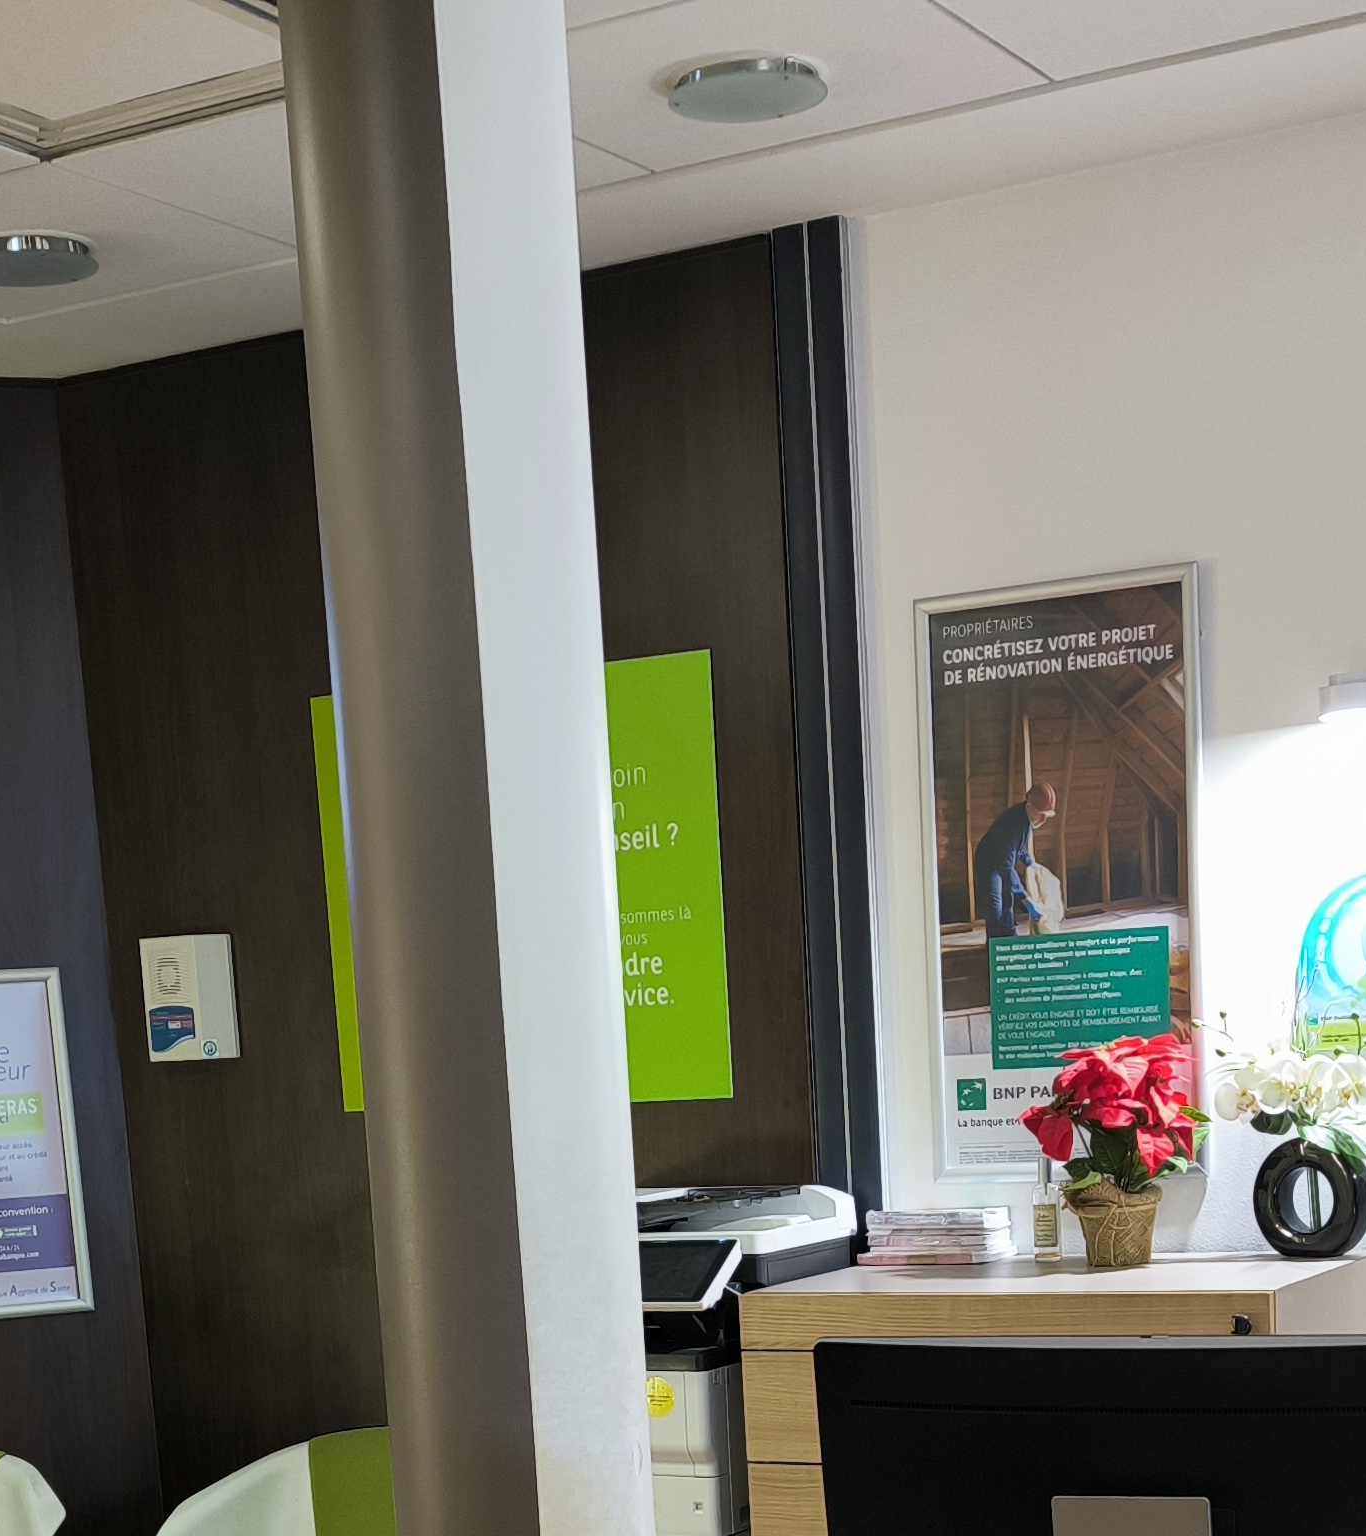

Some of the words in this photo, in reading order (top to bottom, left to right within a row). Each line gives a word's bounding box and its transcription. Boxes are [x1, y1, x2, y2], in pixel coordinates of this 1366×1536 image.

[942, 615, 1034, 640] PROPRIÉTAIRES
[942, 638, 1044, 665] CONCRÉTISEZ
[1047, 631, 1097, 651] VOTRE
[1101, 623, 1156, 645] PROJET
[944, 669, 963, 686] DE
[967, 657, 1063, 683] RÉNOVATION
[1067, 643, 1175, 671] ÉNERGÉTIQUE
[620, 909, 675, 924] sommes
[678, 904, 692, 920] là
[993, 1086, 1026, 1100] BNP
[1030, 1086, 1055, 1098] PA
[958, 1118, 968, 1128] La
[970, 1118, 1003, 1128] banque
